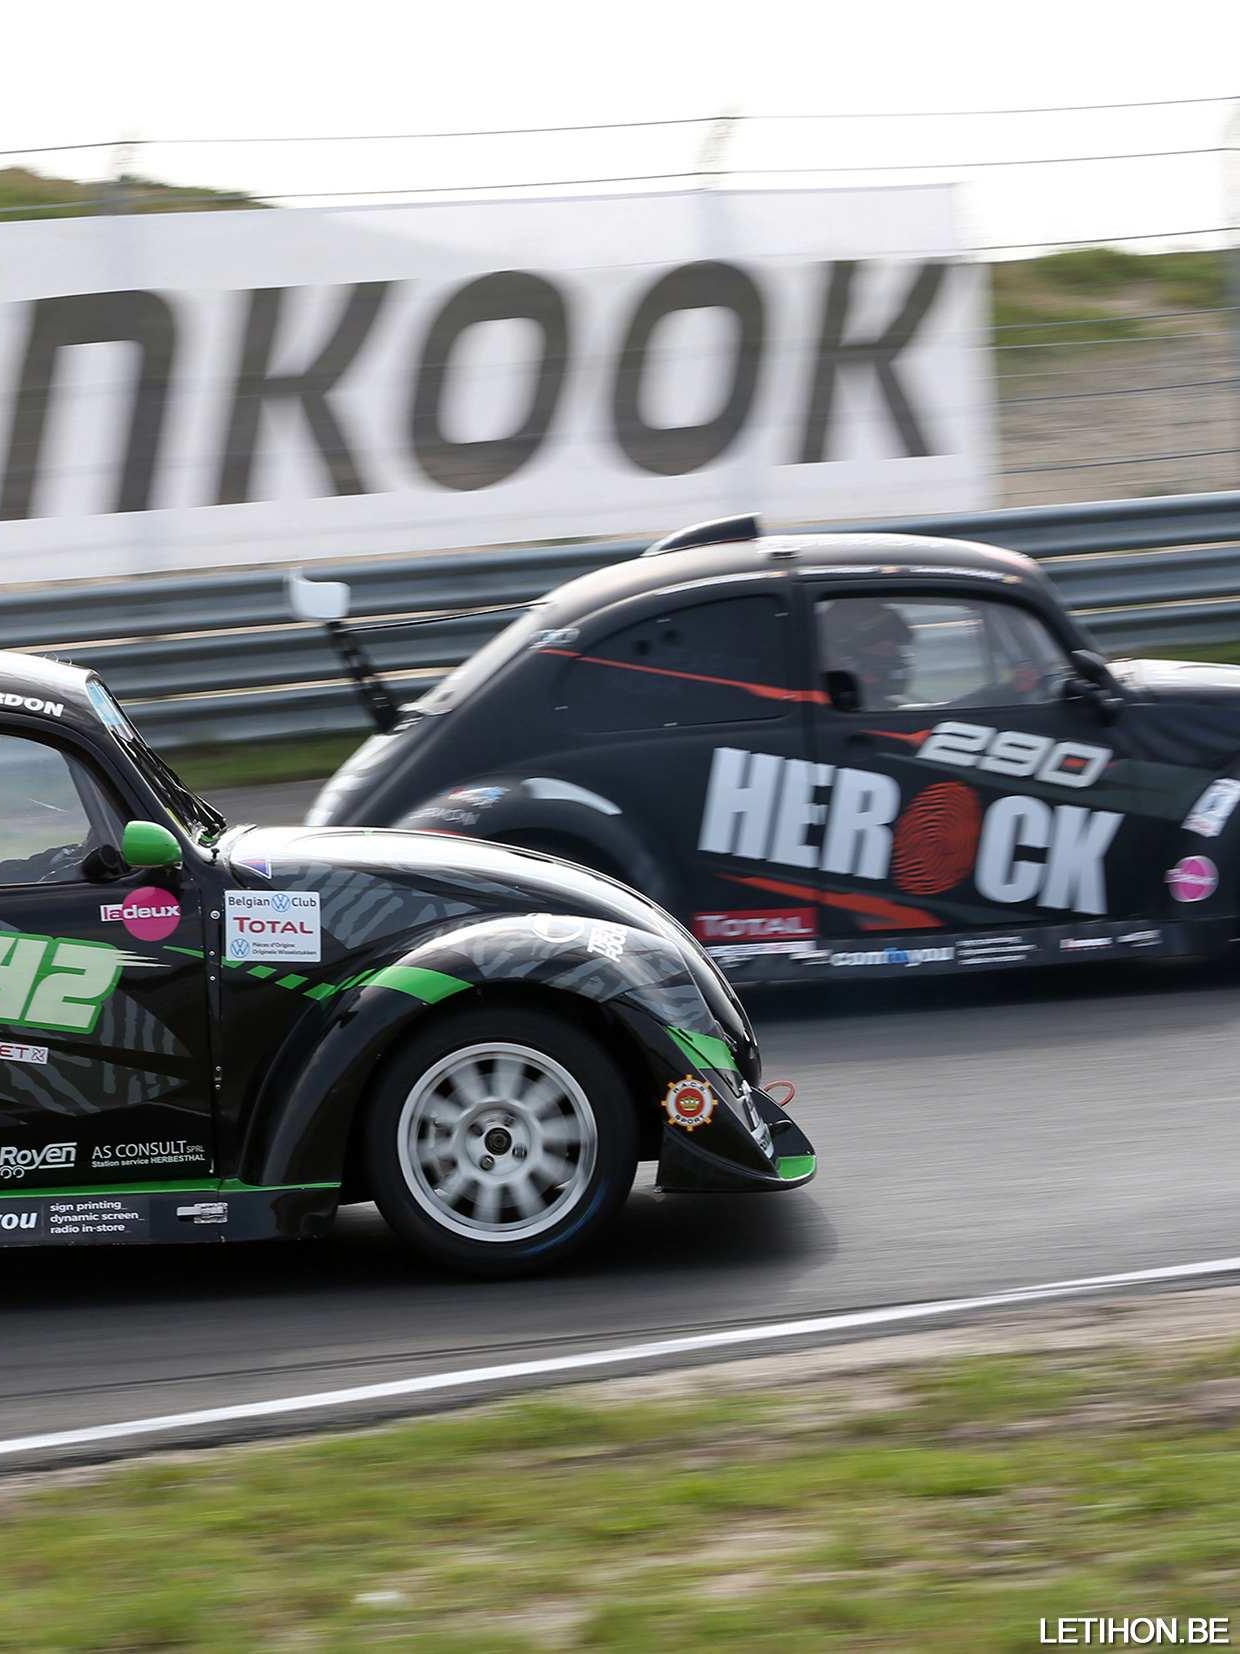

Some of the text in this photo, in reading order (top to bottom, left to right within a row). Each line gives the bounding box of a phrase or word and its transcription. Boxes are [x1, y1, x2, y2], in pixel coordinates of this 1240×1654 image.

[915, 720, 1113, 788] 290
[228, 896, 270, 908] Belgian
[291, 897, 317, 907] Club
[233, 917, 314, 934] TOTAL
[695, 913, 814, 937] TOTAL
[675, 1114, 705, 1124] SPORT
[91, 1140, 205, 1160] AS CONSULT SPRL
[91, 1154, 206, 1168] Station service HERBESTHAL
[49, 1203, 74, 1213] sign
[49, 1212, 100, 1224] dynamic
[50, 1224, 80, 1234] radio
